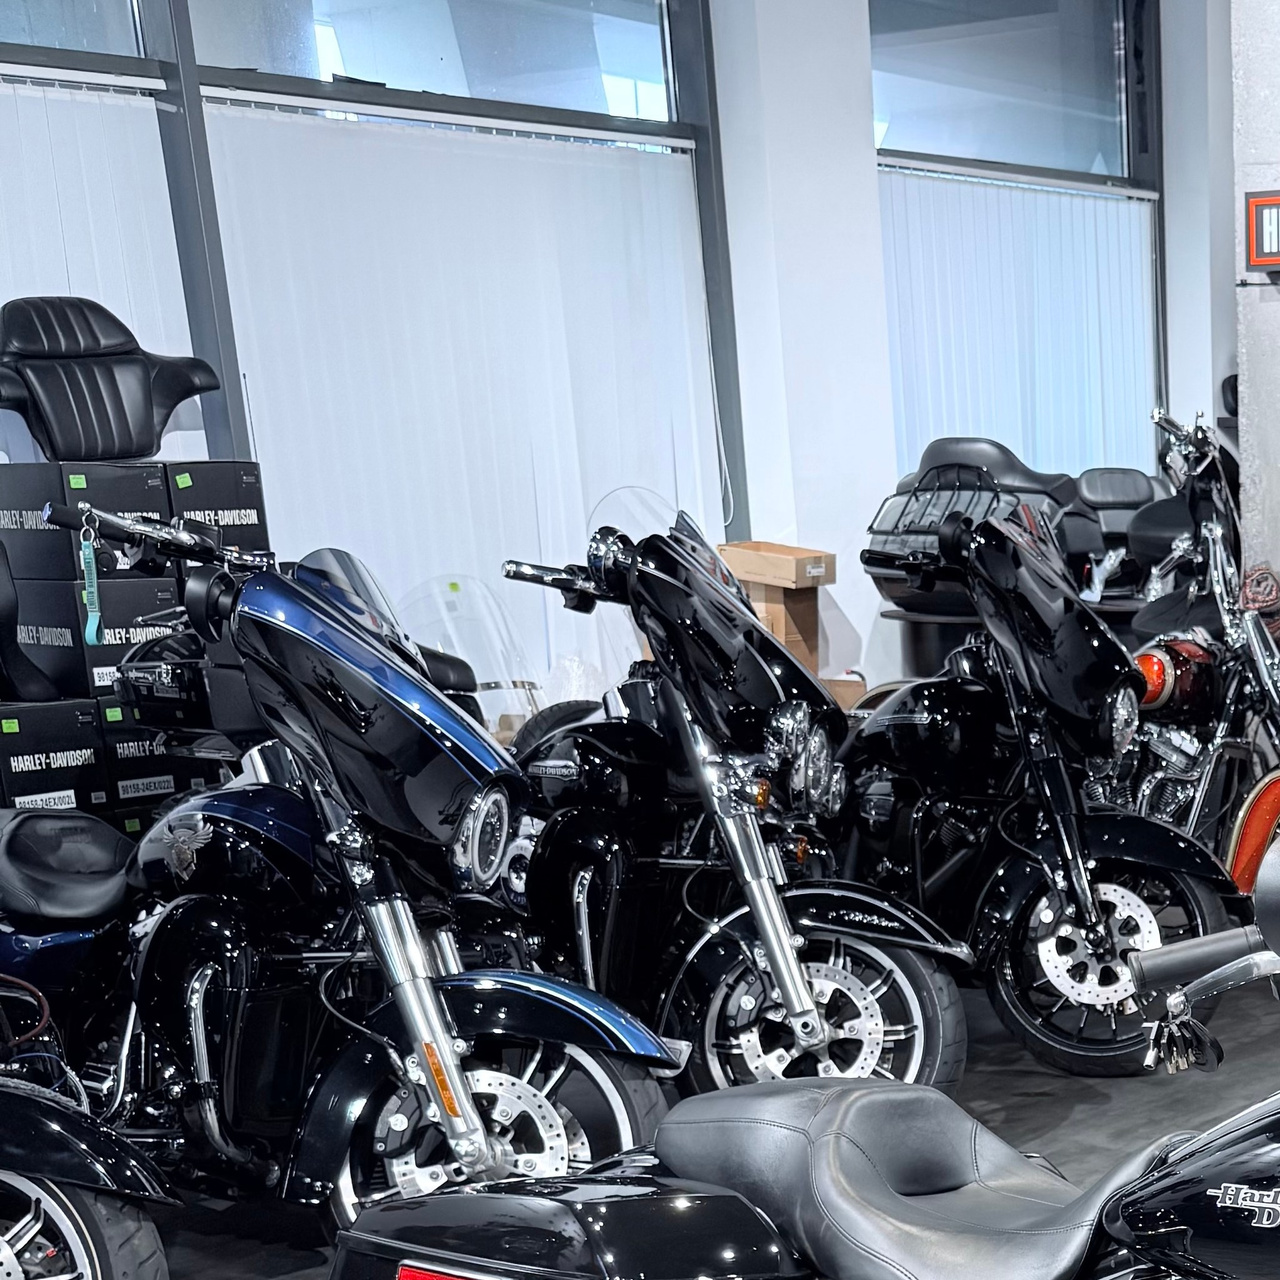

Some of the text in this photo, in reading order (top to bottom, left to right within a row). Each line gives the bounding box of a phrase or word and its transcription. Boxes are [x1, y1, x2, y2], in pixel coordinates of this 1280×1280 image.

[0, 510, 60, 530] ARLEY-DAVID
[17, 624, 74, 647] ARLEY-DAVIDSON
[10, 748, 95, 773] HARLEY-DAVIDSON
